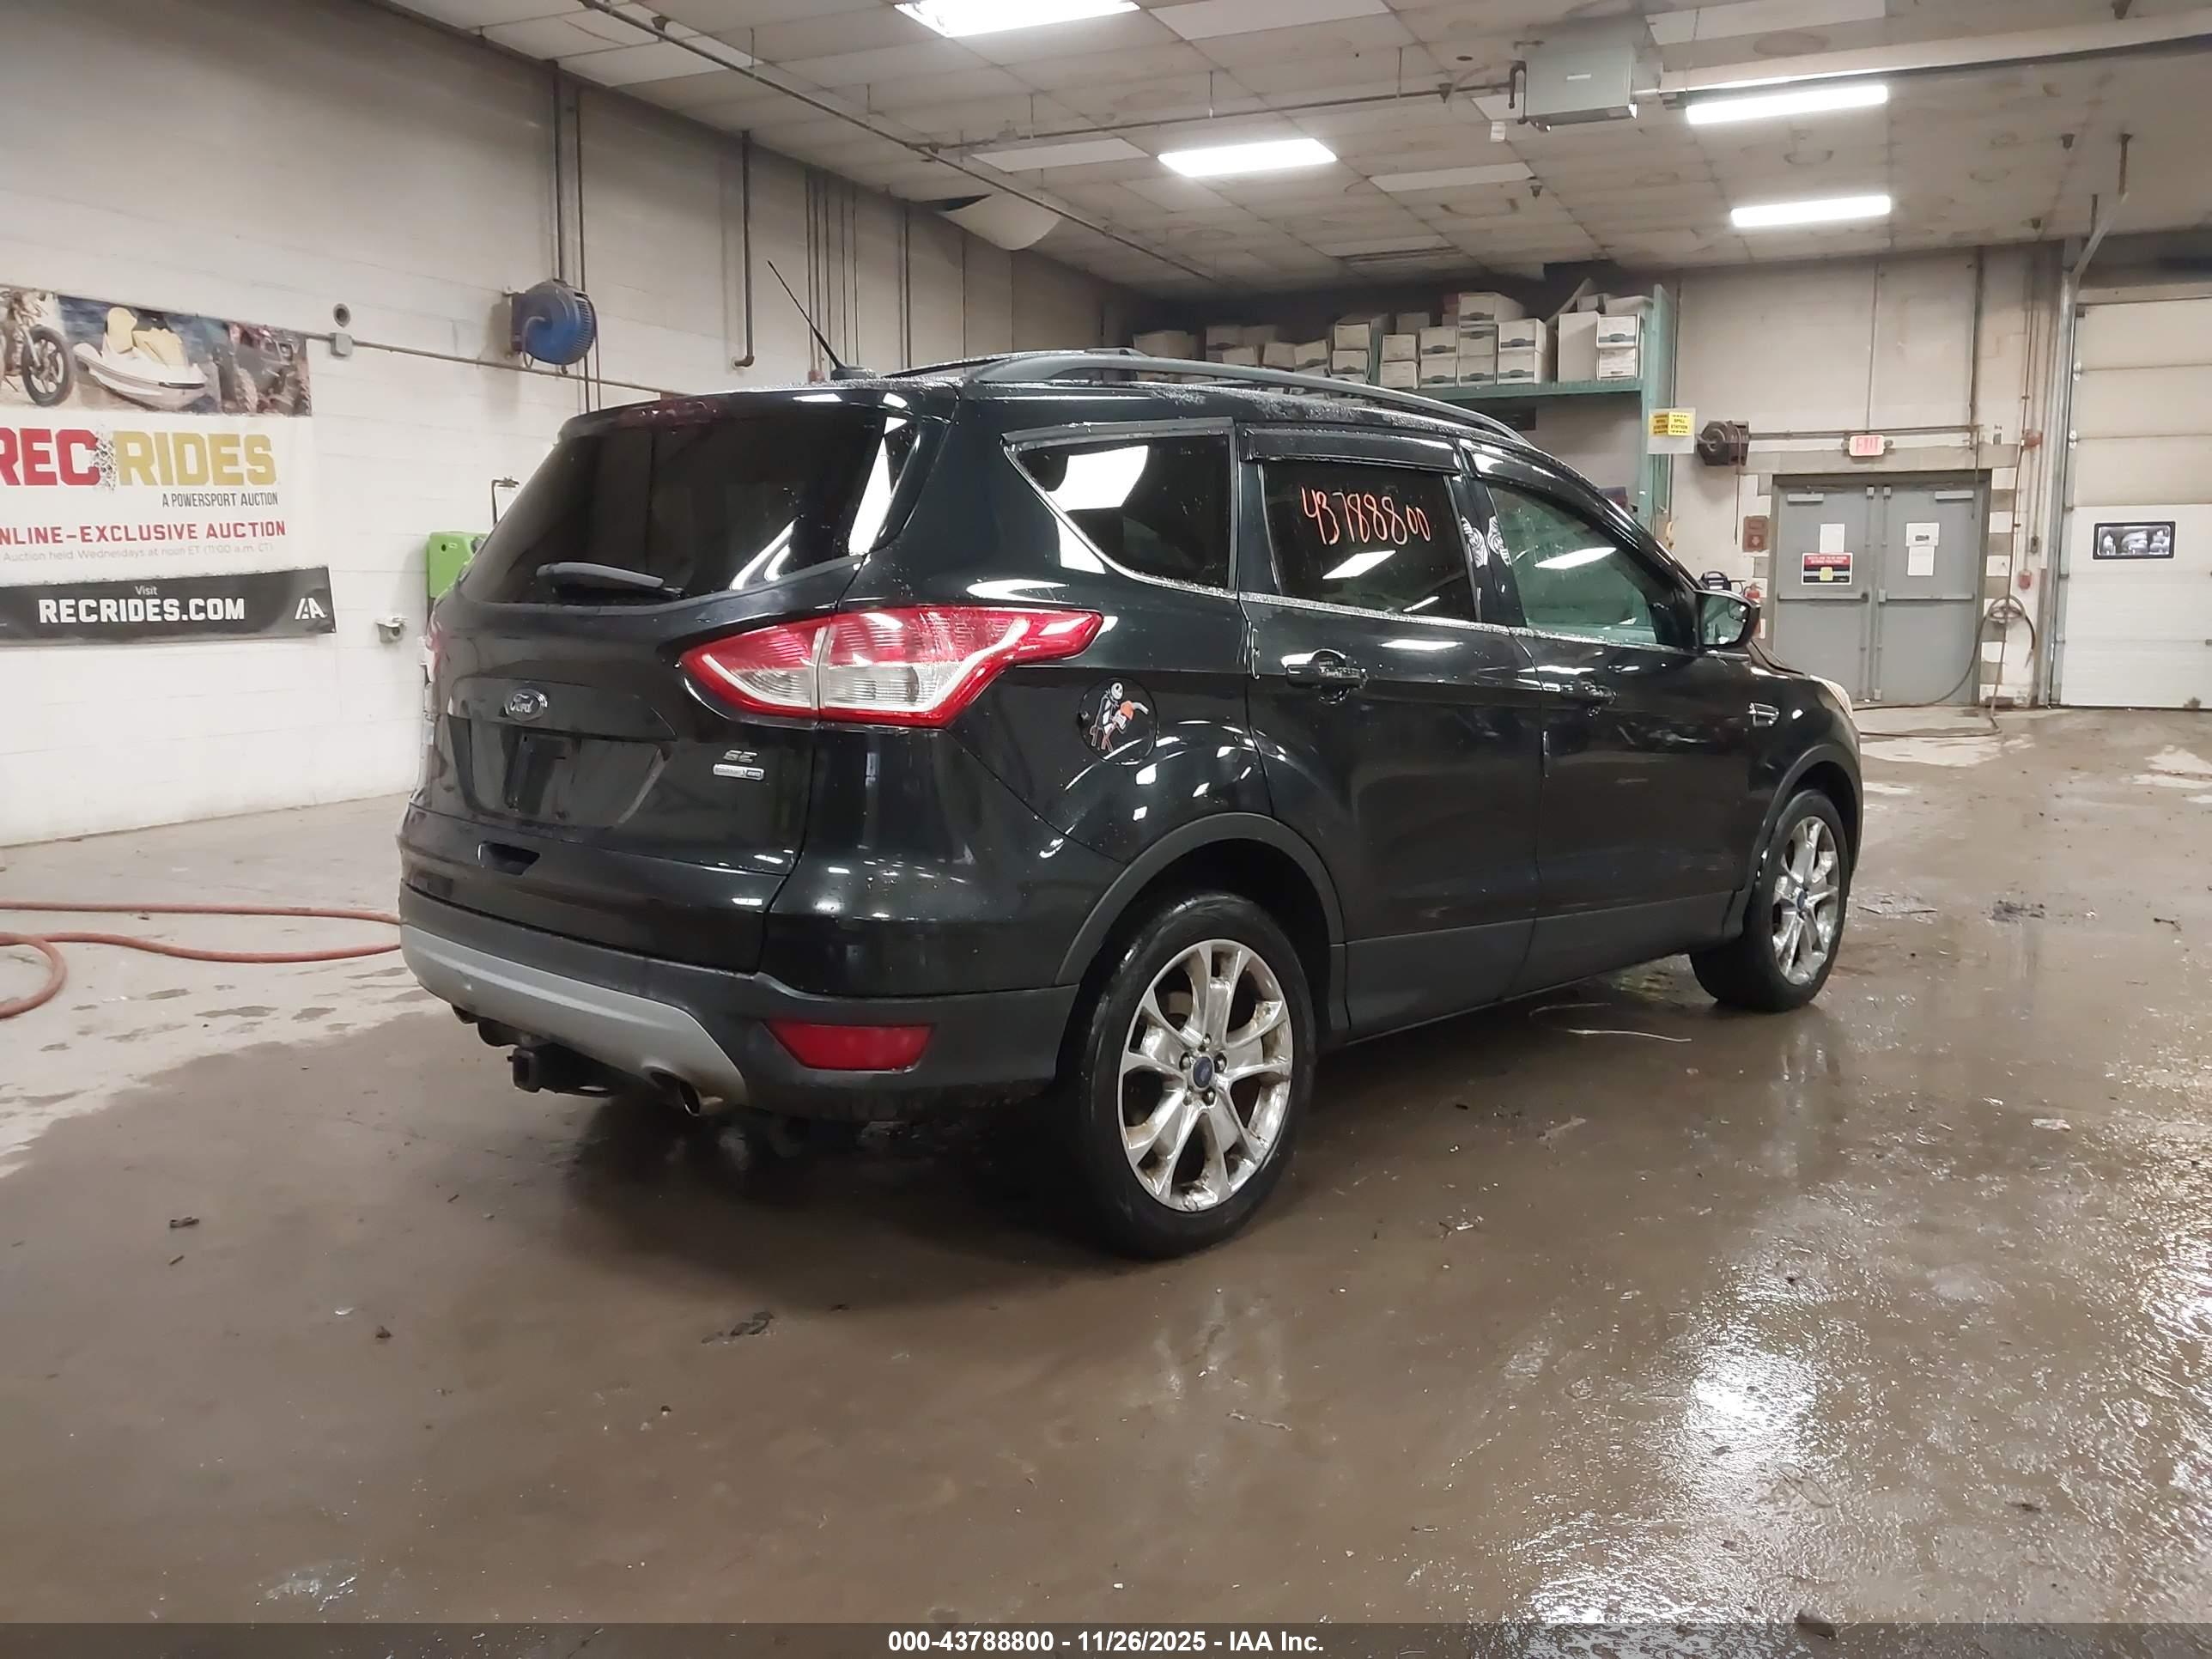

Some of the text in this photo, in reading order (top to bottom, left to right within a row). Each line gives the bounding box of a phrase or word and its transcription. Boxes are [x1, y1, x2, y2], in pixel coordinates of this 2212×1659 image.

[1855, 436, 1881, 453] EXIT
[113, 430, 277, 486] RIDES
[162, 491, 278, 507] A POWERSPORT AUCTION
[1301, 486, 1431, 546] 43788800
[206, 520, 286, 539] AUCTION
[135, 586, 158, 596] Visit
[39, 598, 246, 623] RECRIDES.COM
[509, 693, 534, 714] Ford
[723, 750, 758, 763] SE
